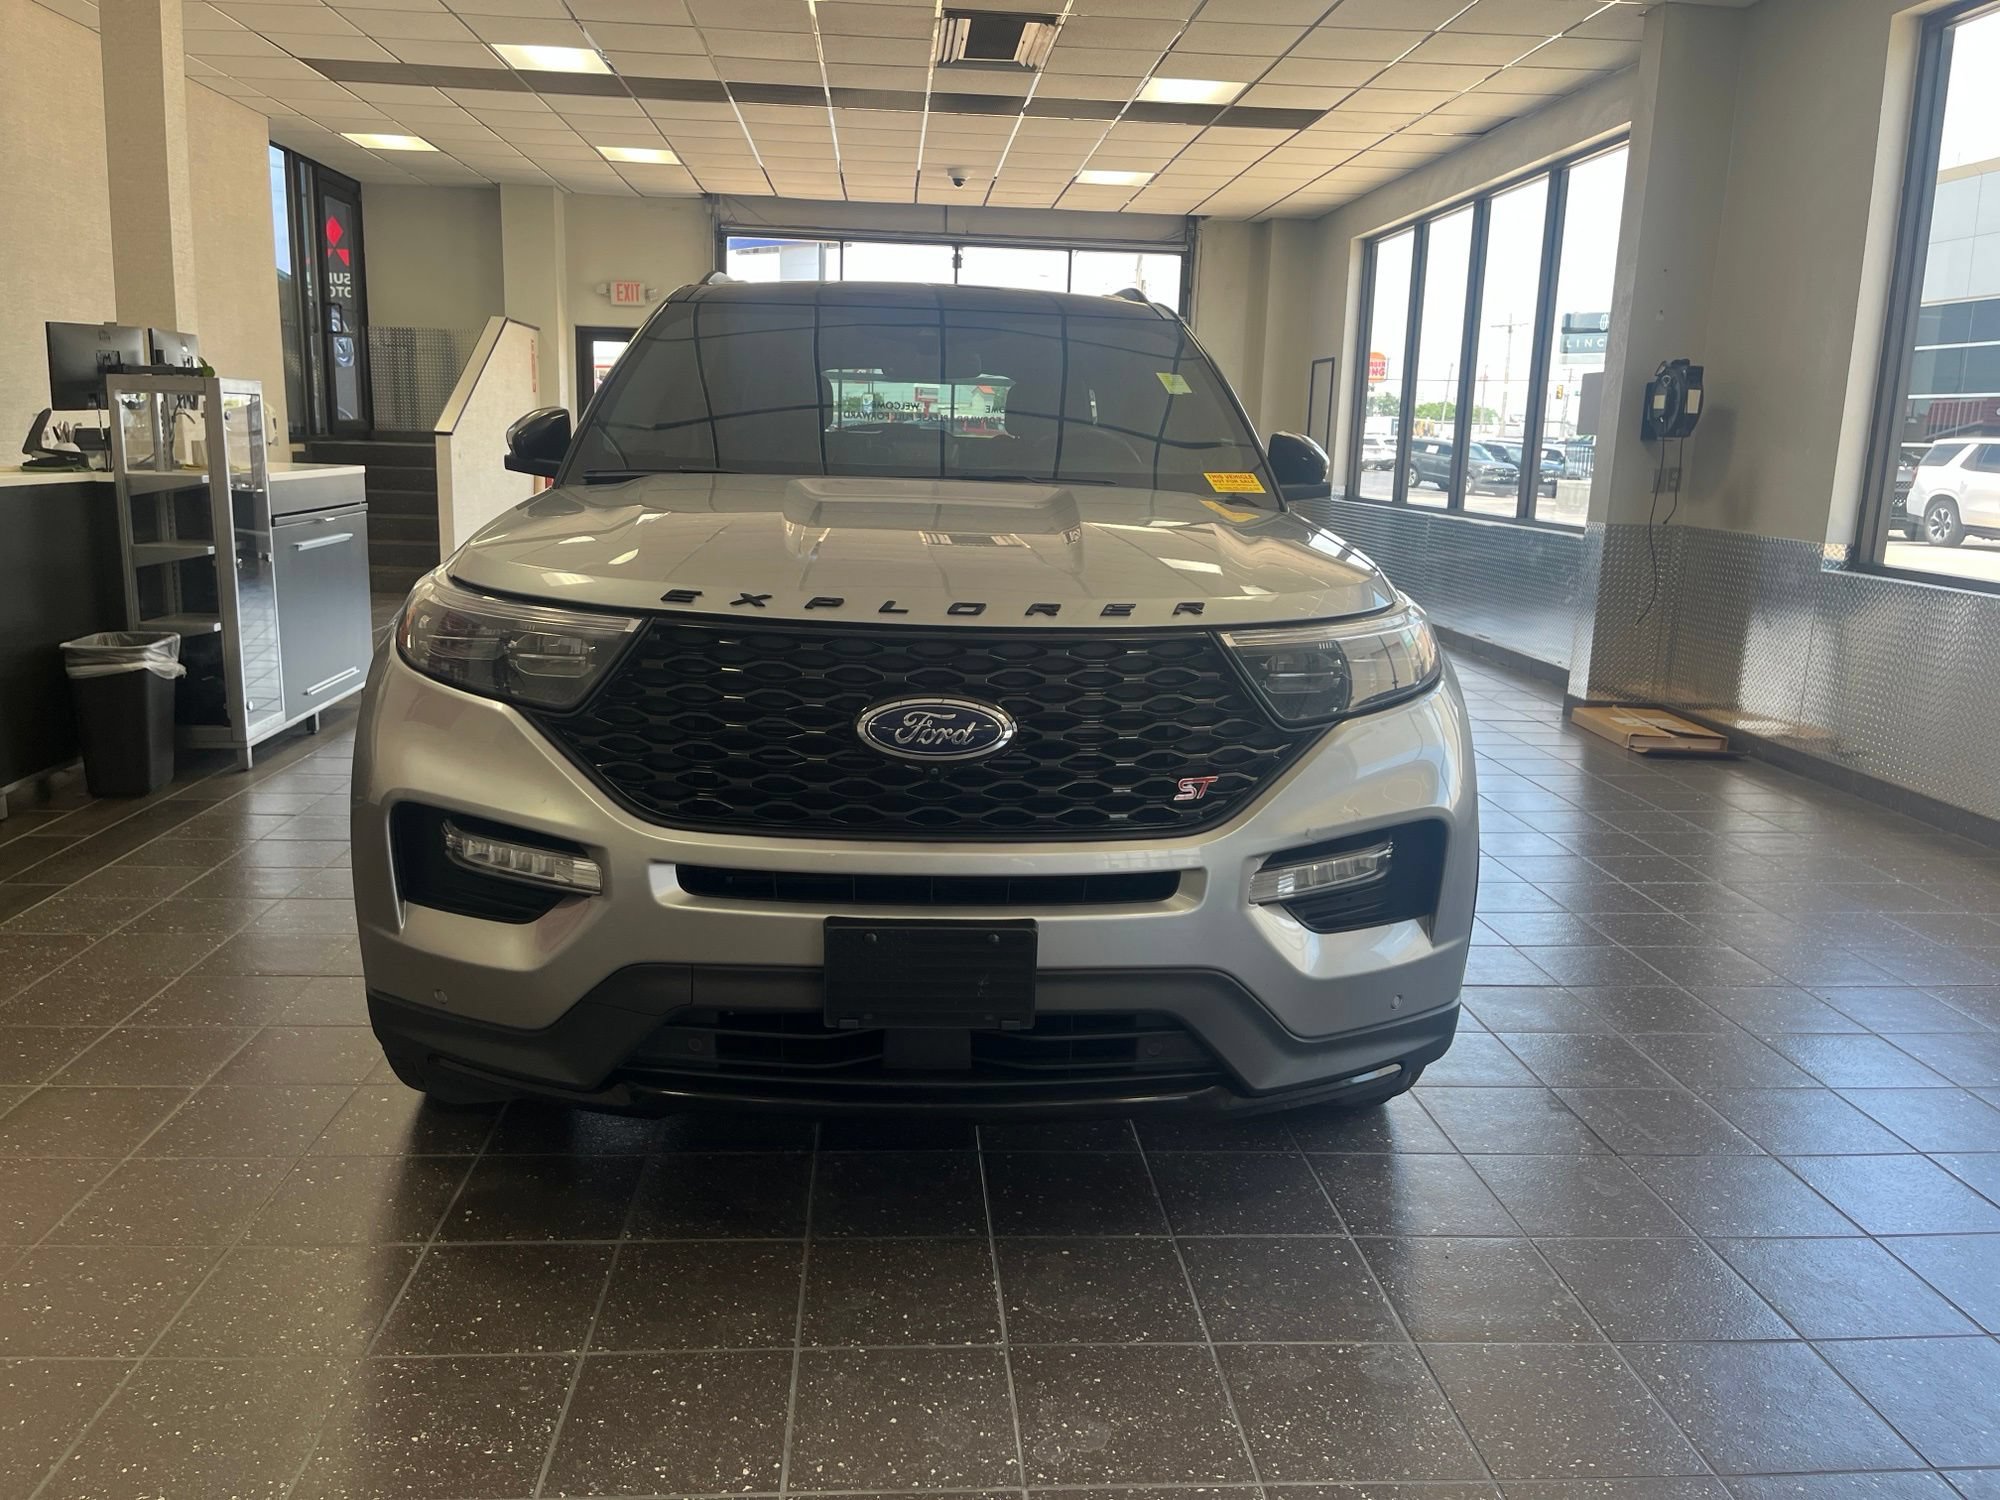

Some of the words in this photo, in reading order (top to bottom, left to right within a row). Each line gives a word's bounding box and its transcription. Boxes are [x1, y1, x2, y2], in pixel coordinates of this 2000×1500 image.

[616, 283, 640, 302] EXIT
[1566, 338, 1604, 348] LINC
[660, 589, 1205, 617] EXPLORER
[894, 710, 975, 747] Ford
[1173, 776, 1218, 801] ST
